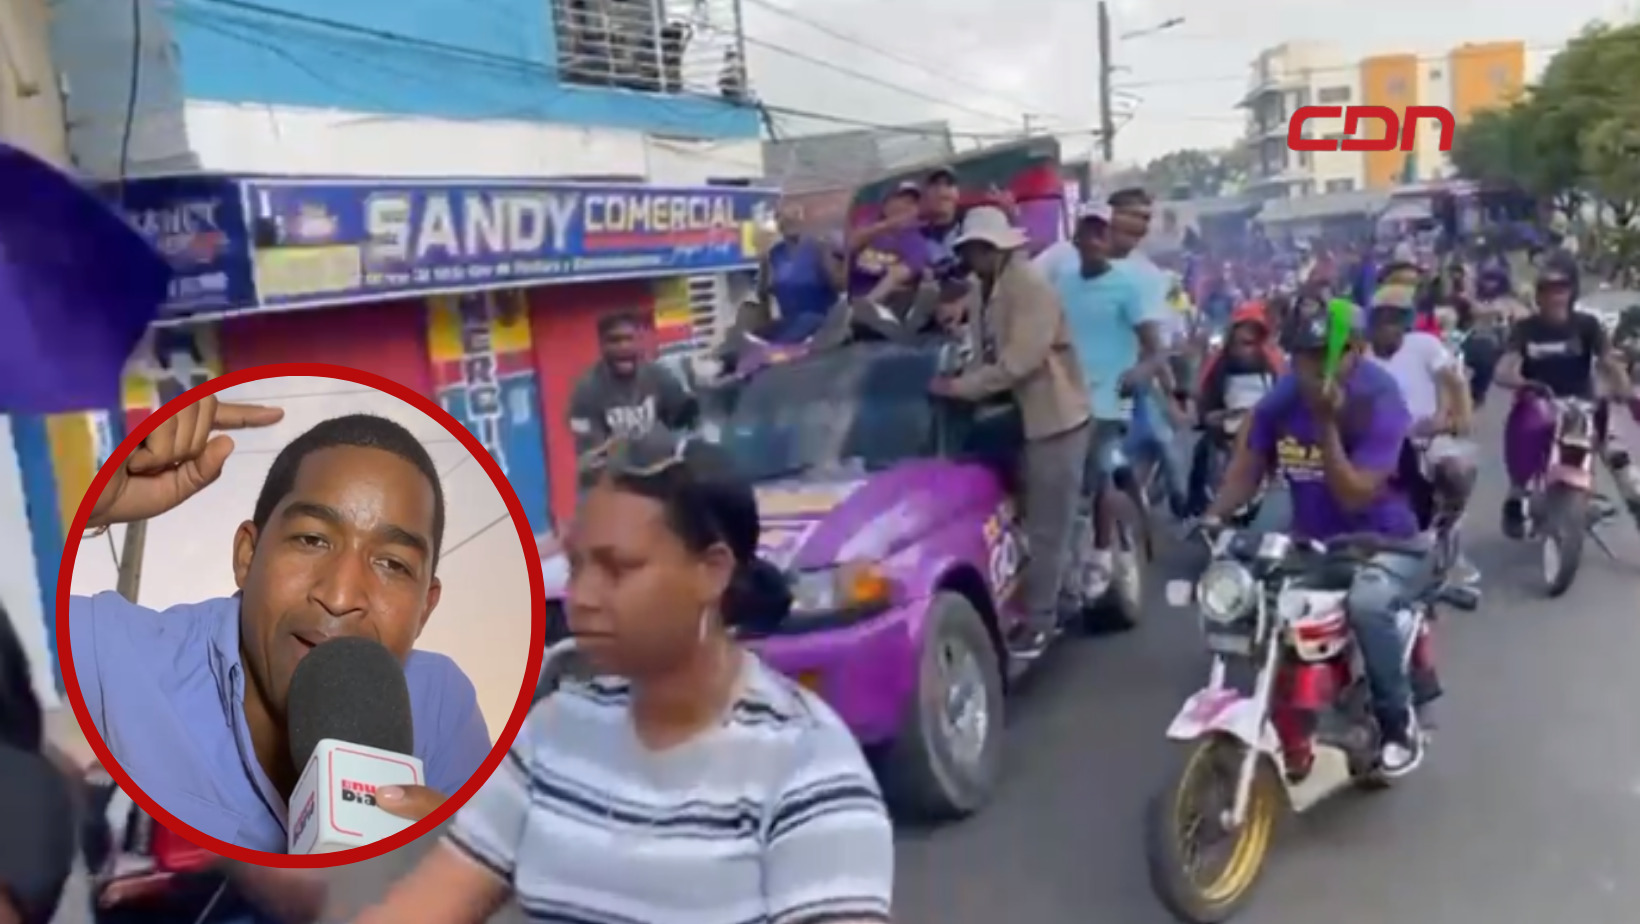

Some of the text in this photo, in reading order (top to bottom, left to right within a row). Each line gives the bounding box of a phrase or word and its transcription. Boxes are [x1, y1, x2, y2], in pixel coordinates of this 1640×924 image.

[364, 190, 580, 261] SANDY
[584, 194, 741, 231] COMERCIAL
[341, 789, 377, 807] Dia
